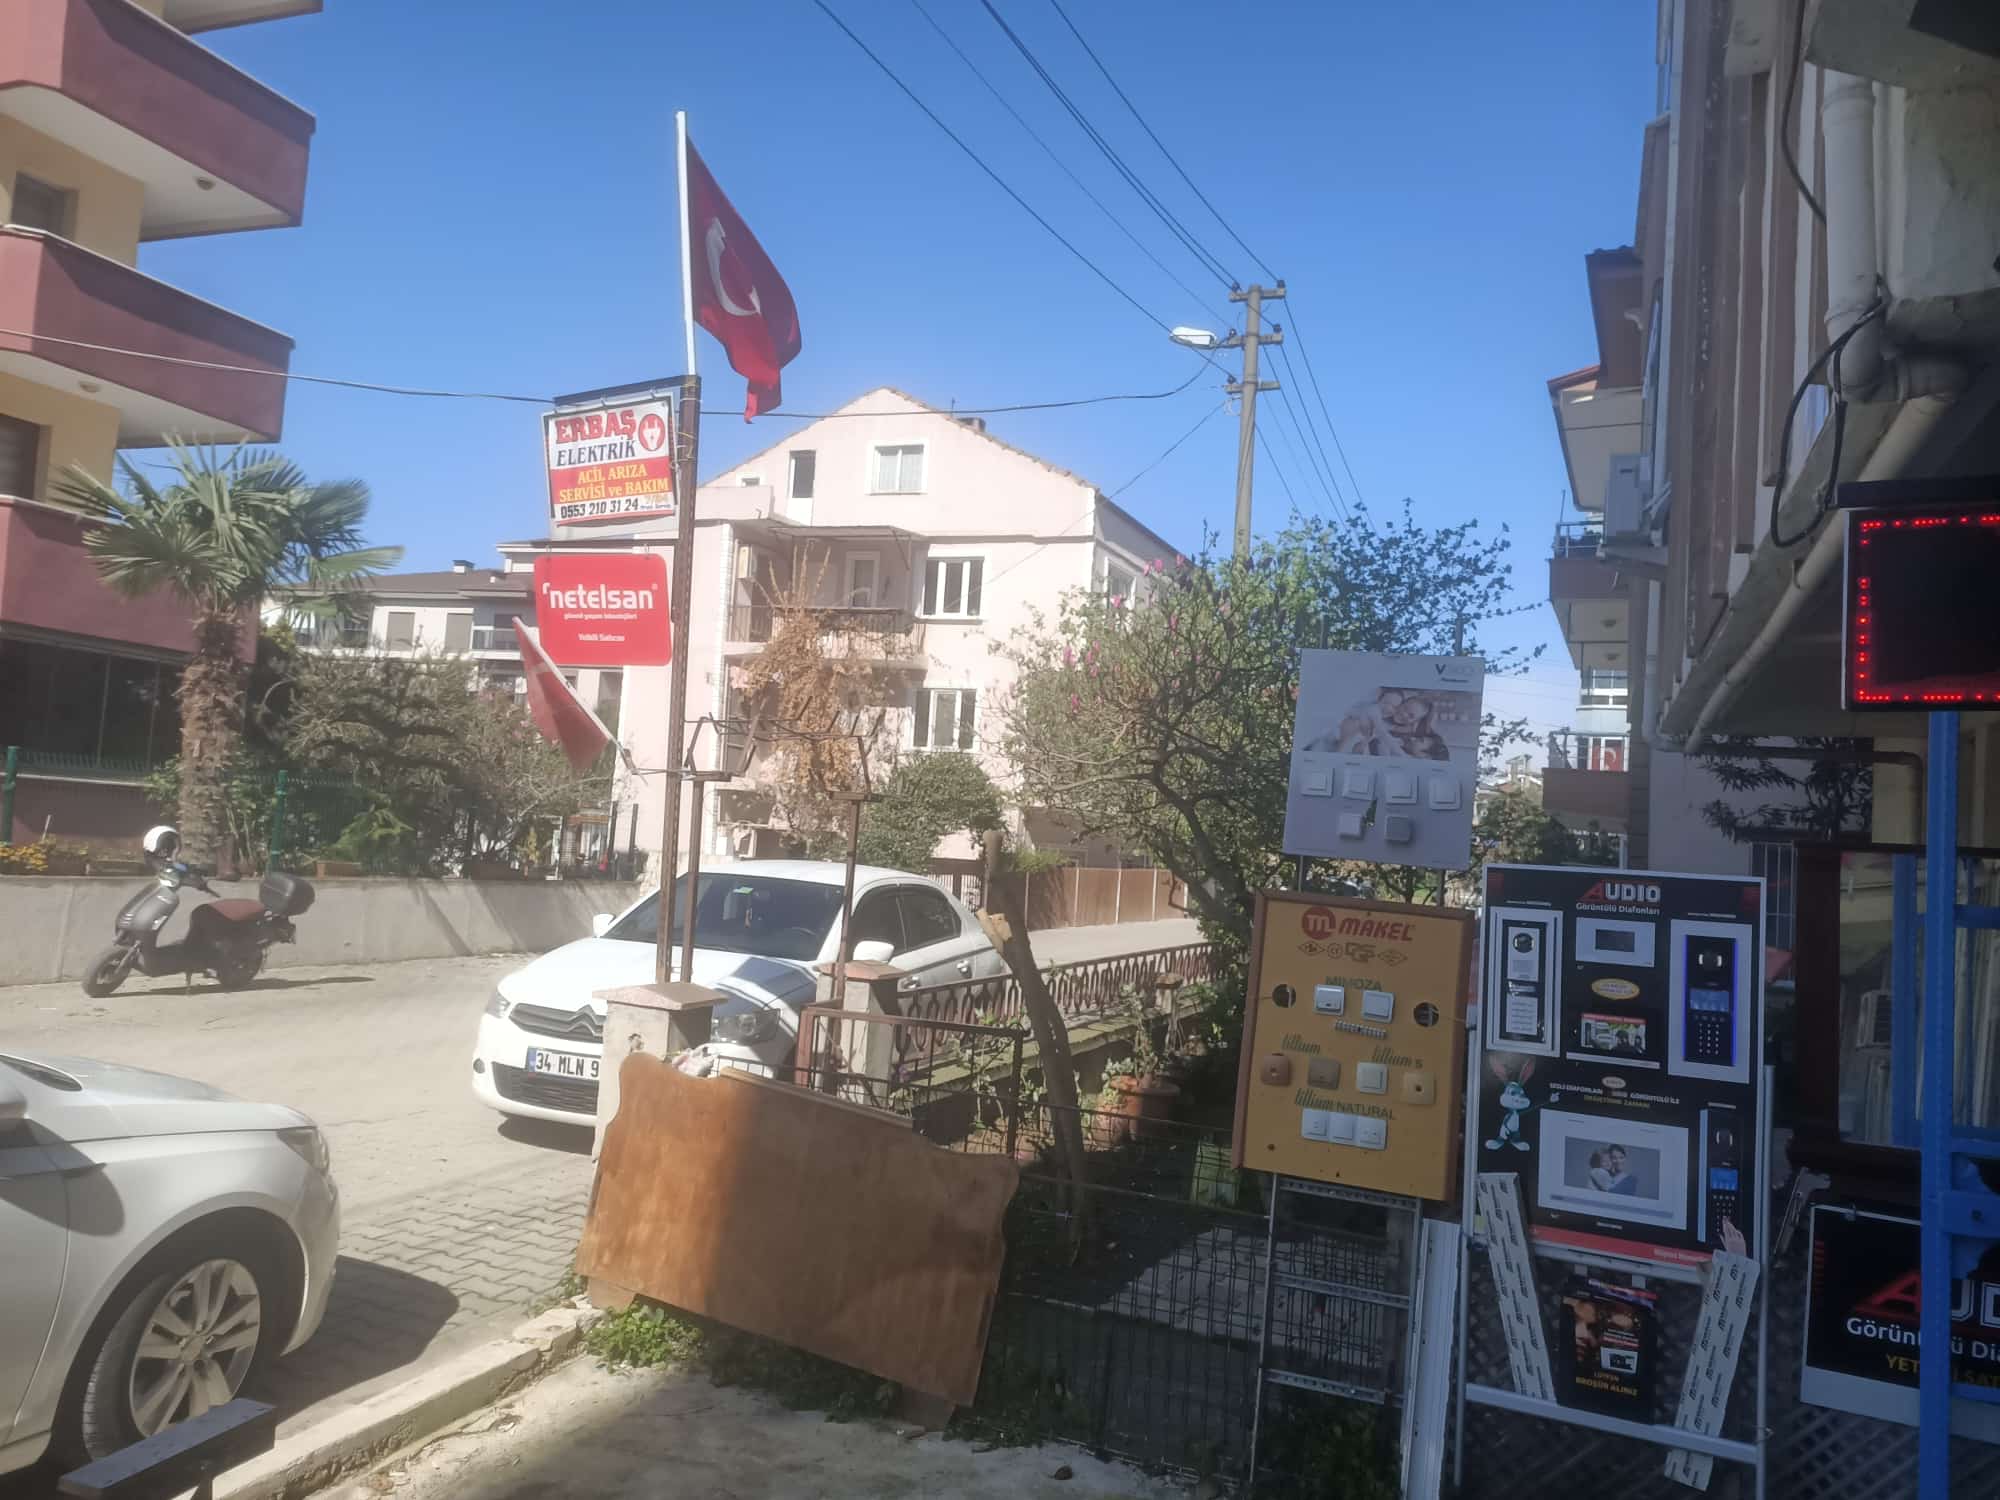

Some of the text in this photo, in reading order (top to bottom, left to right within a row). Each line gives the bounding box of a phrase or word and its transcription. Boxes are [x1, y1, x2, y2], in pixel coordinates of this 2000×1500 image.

[555, 408, 637, 444] ERBAŞ
[556, 437, 637, 467] ELEKTRİK
[577, 462, 648, 485] ACİL ARIZA
[559, 477, 669, 503] SERVİSİ ve BAKIM
[560, 502, 586, 519] 0553
[588, 500, 607, 515] 210
[609, 499, 622, 512] 31
[625, 497, 640, 511] 24
[548, 583, 654, 609] netelsan
[1576, 880, 1662, 904] AUDIO
[1575, 902, 1617, 913] Görüntülü
[535, 1052, 600, 1078] 34 MLN 9
